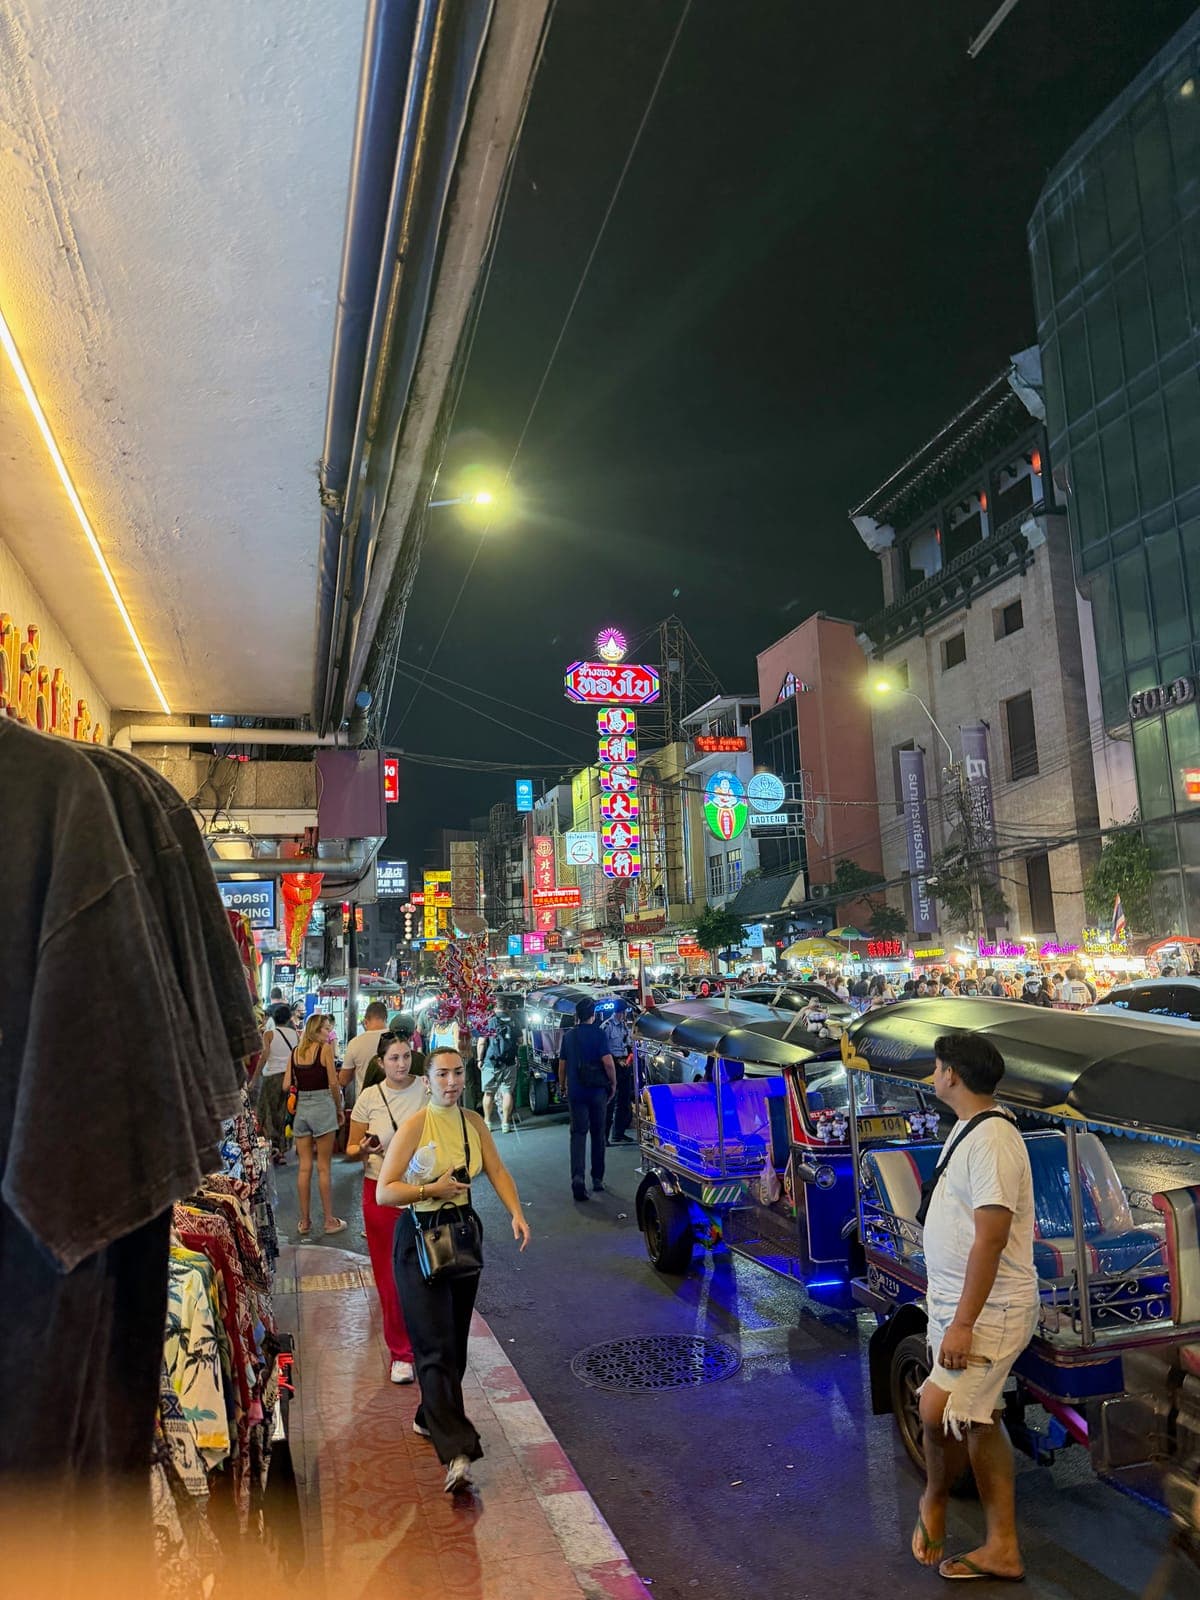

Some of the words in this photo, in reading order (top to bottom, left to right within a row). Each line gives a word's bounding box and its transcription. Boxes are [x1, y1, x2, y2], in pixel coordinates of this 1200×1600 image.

[577, 670, 651, 698] ทองใบ
[1129, 676, 1192, 719] GOLD
[539, 858, 553, 925] 北京堂
